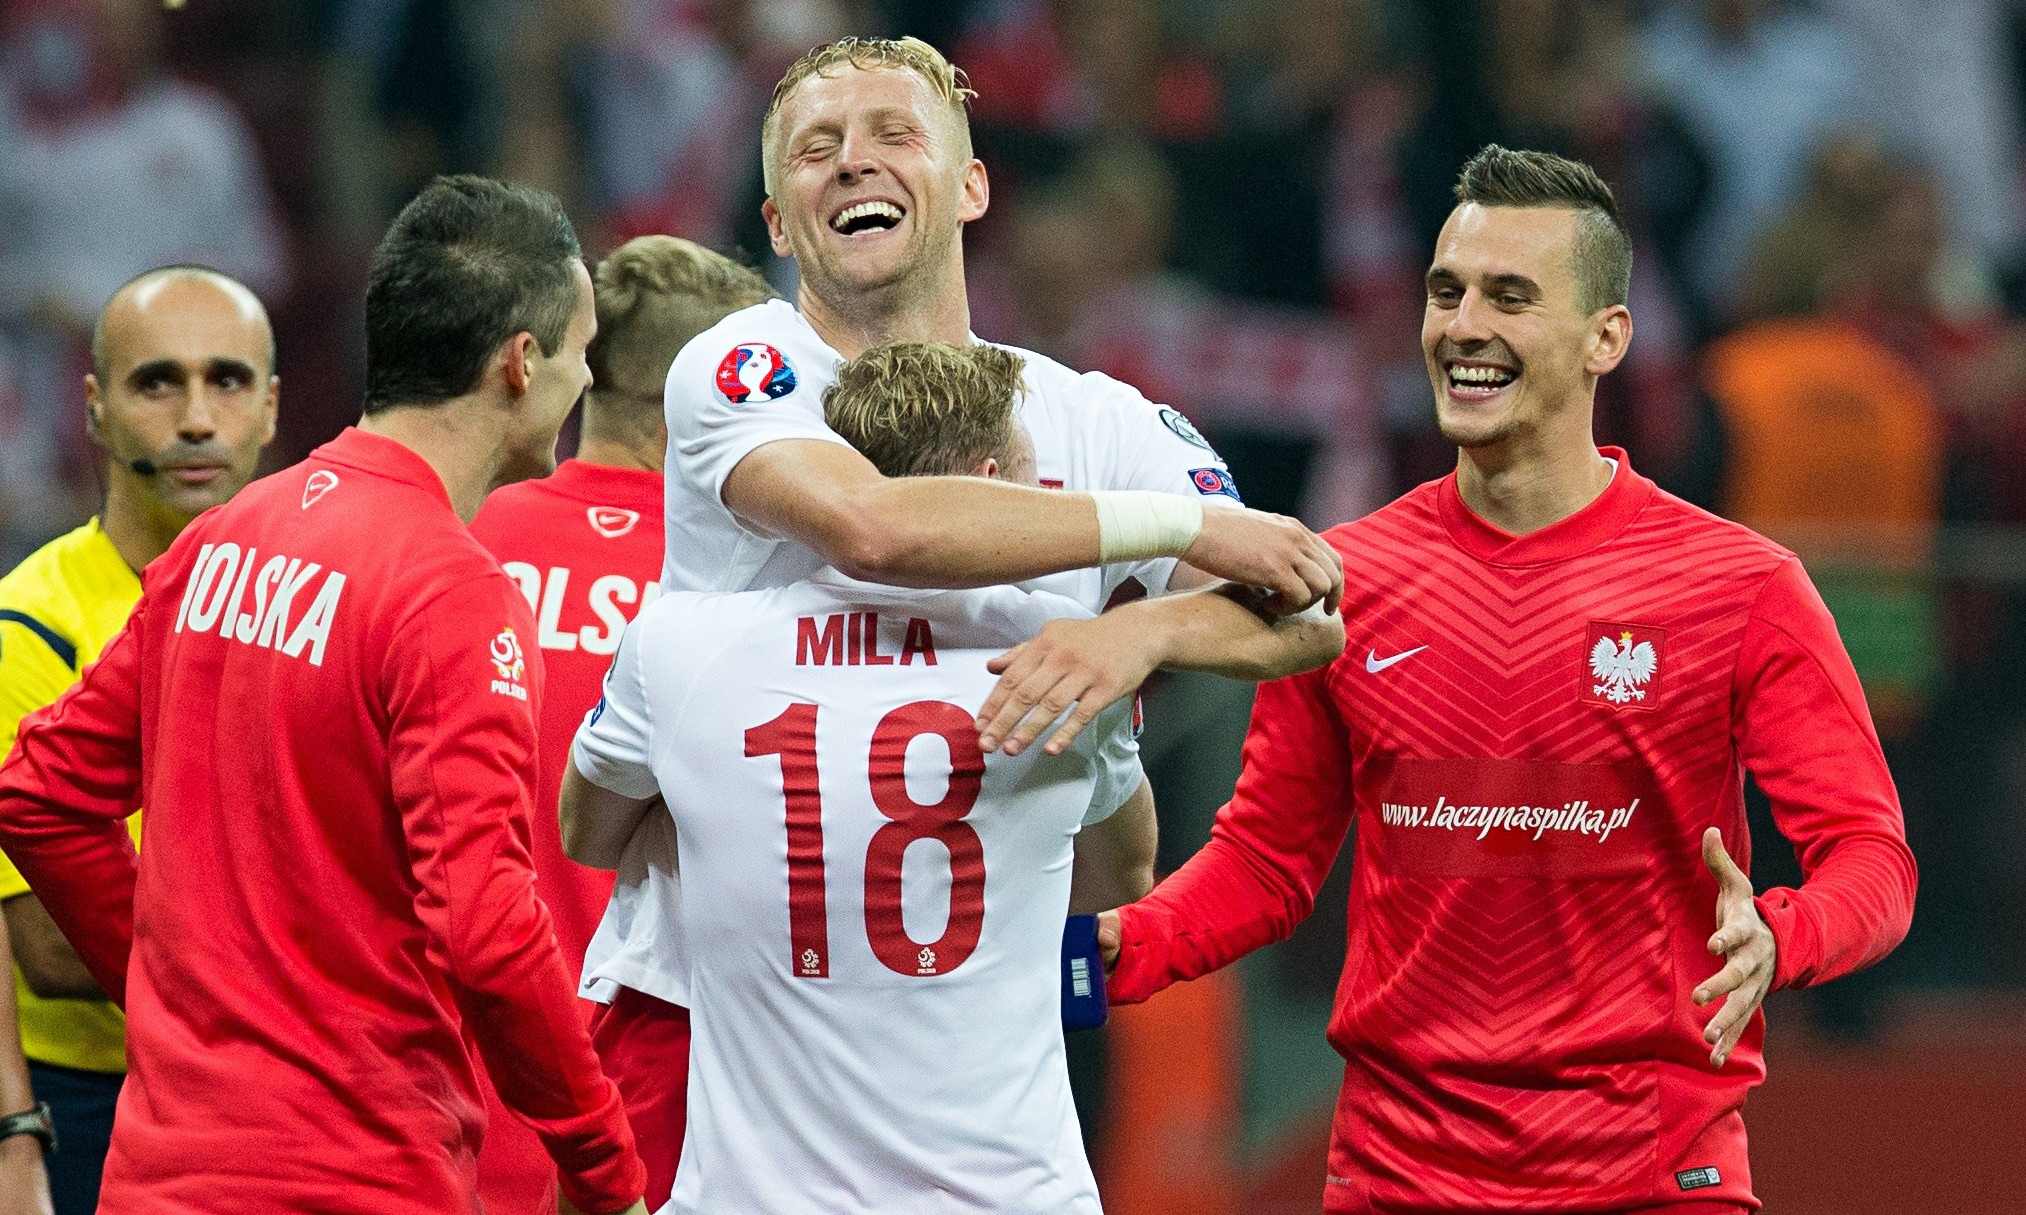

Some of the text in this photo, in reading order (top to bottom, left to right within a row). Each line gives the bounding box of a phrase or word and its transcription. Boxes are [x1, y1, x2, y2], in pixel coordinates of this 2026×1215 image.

[795, 611, 938, 666] MILA
[744, 700, 986, 977] 18
[1382, 796, 1640, 843] www.laczynaspilka.pl
